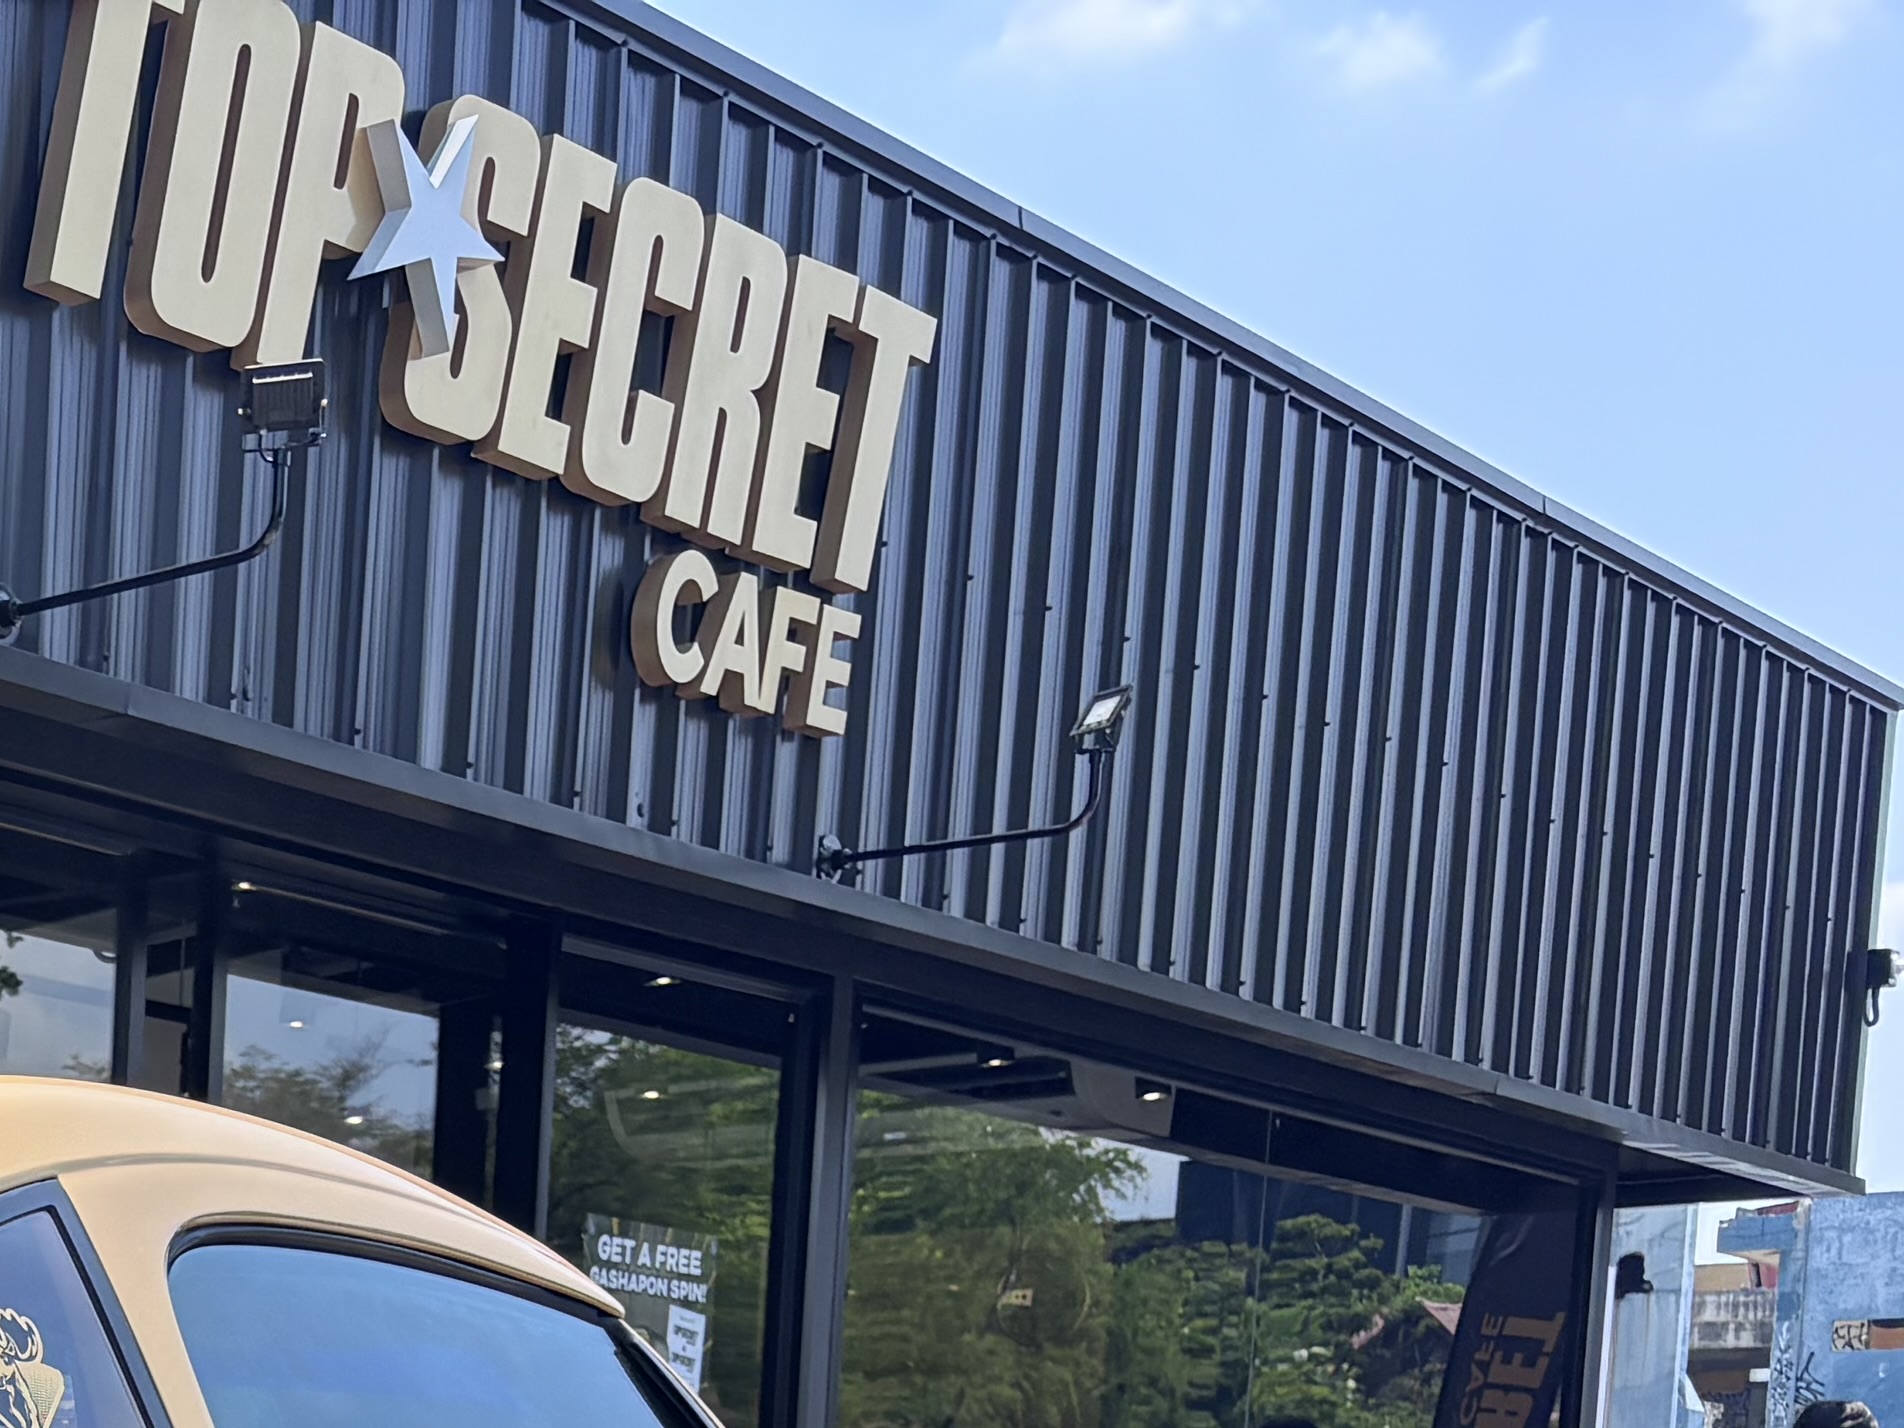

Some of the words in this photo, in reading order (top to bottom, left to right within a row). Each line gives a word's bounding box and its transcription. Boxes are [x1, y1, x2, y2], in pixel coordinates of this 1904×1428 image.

[24, 0, 406, 370] TOP
[382, 94, 937, 594] SECRET
[631, 549, 862, 738] CAFE
[589, 1265, 669, 1298] GASHAPON
[670, 1280, 708, 1304] SPIN!
[597, 1233, 637, 1265] GET
[638, 1242, 651, 1268] A
[655, 1243, 703, 1277] FREE
